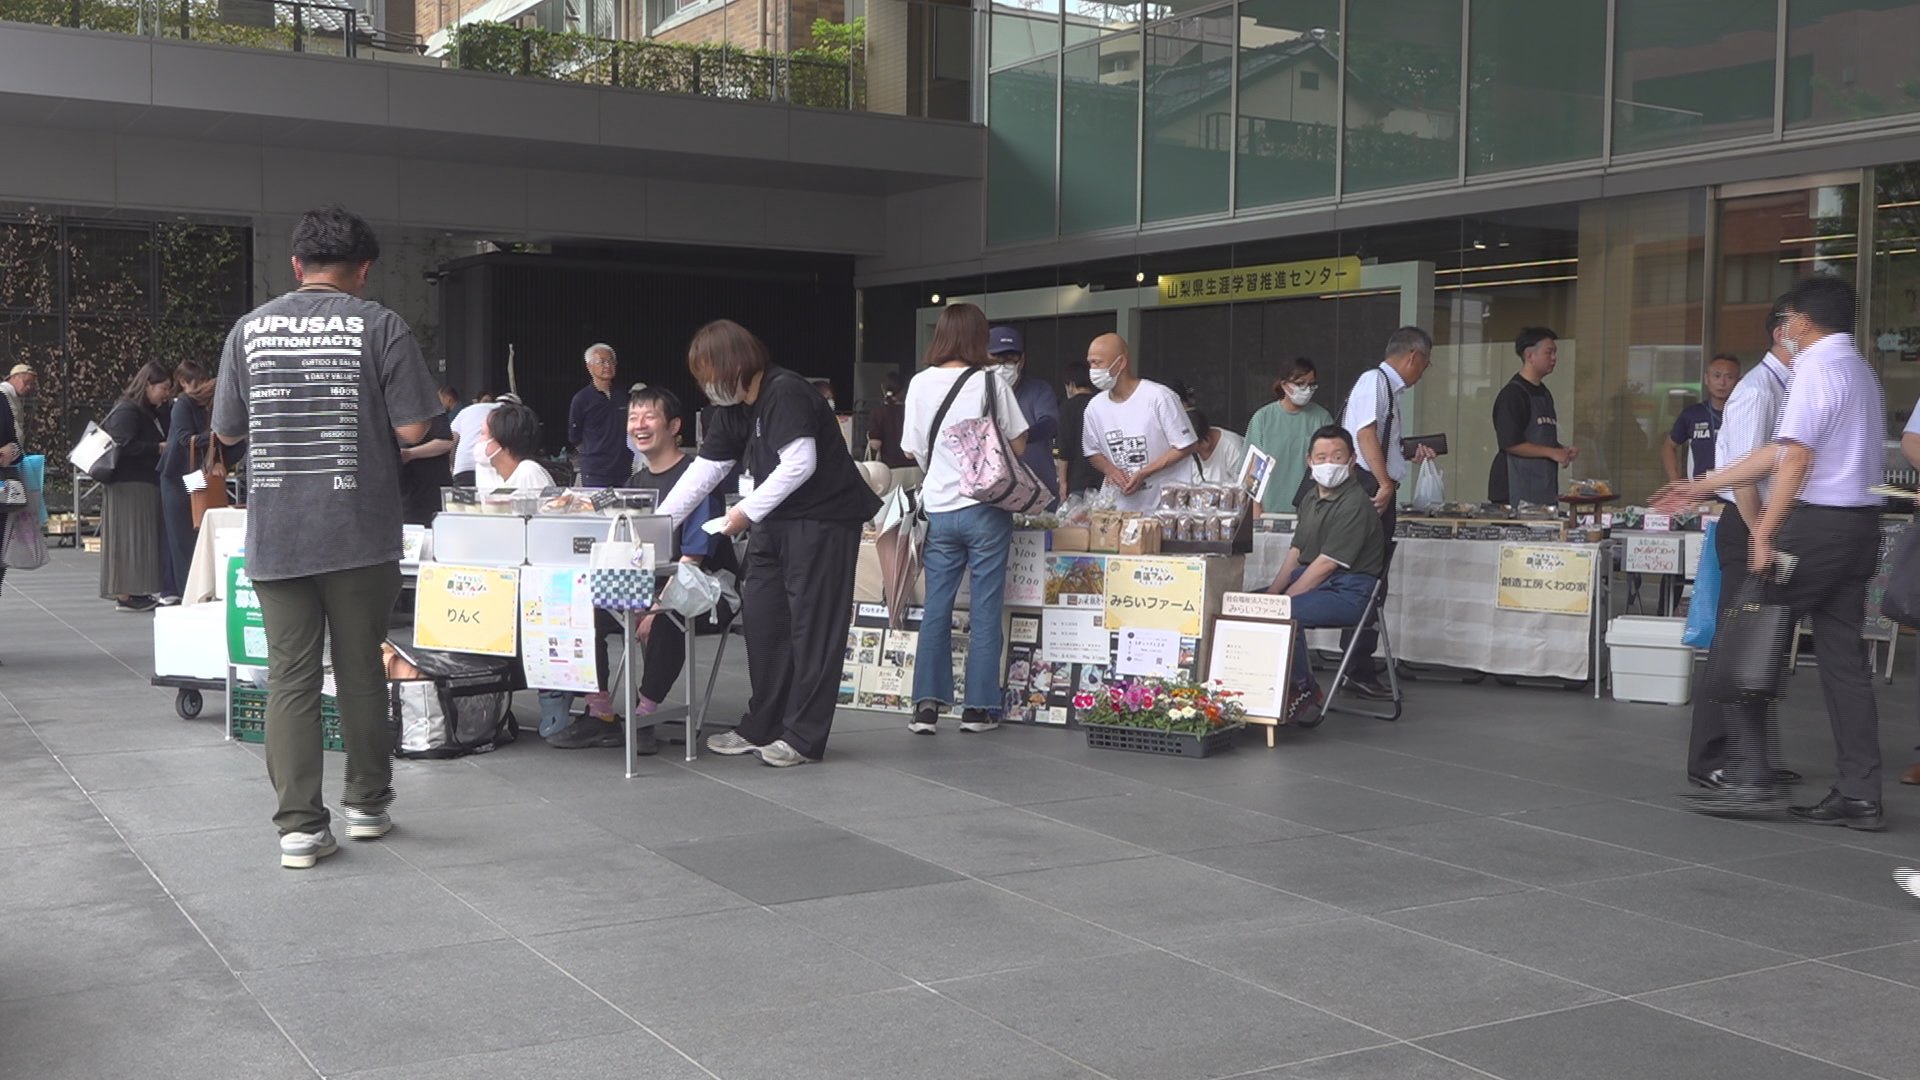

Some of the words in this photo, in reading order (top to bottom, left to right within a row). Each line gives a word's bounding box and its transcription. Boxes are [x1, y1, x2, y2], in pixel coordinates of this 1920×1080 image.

[1167, 266, 1347, 299] 山梨県生涯学習推進センター
[244, 315, 364, 339] PUPUSAS
[312, 335, 362, 348] FACTS
[1693, 429, 1710, 439] FILA
[1501, 576, 1587, 592] 創造工房くわの家
[1110, 594, 1195, 612] みらいファーム
[1228, 603, 1285, 617] みらいファーム
[447, 608, 480, 624] りんく
